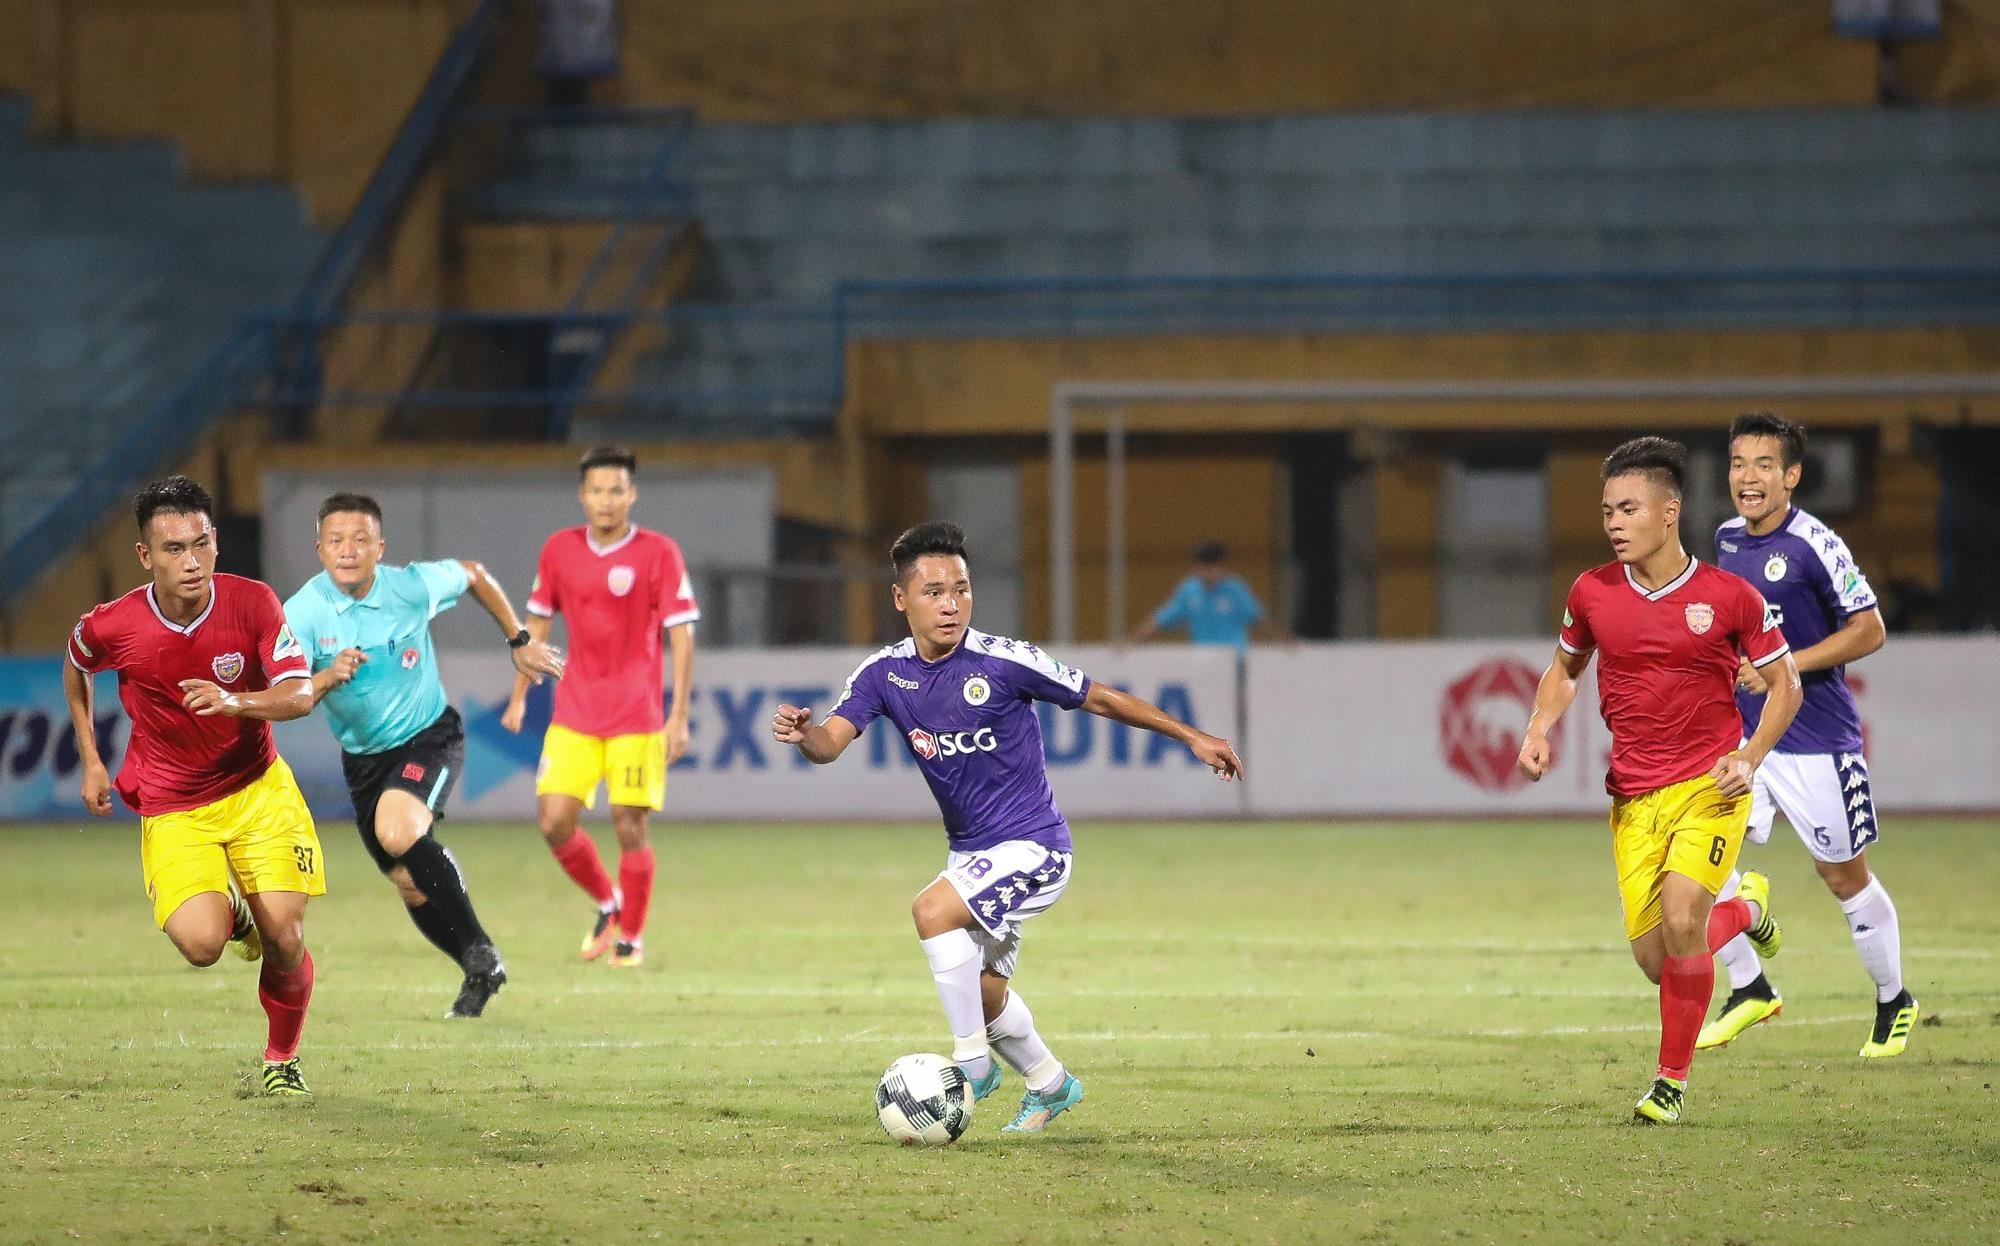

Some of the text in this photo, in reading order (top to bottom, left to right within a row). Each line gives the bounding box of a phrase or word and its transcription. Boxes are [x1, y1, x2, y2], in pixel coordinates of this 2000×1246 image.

[887, 671, 919, 690] Kappa
[939, 727, 998, 756] SCG
[624, 765, 644, 789] 11
[293, 845, 314, 875] 37
[1708, 835, 1727, 867] 6
[957, 855, 993, 880] 18
